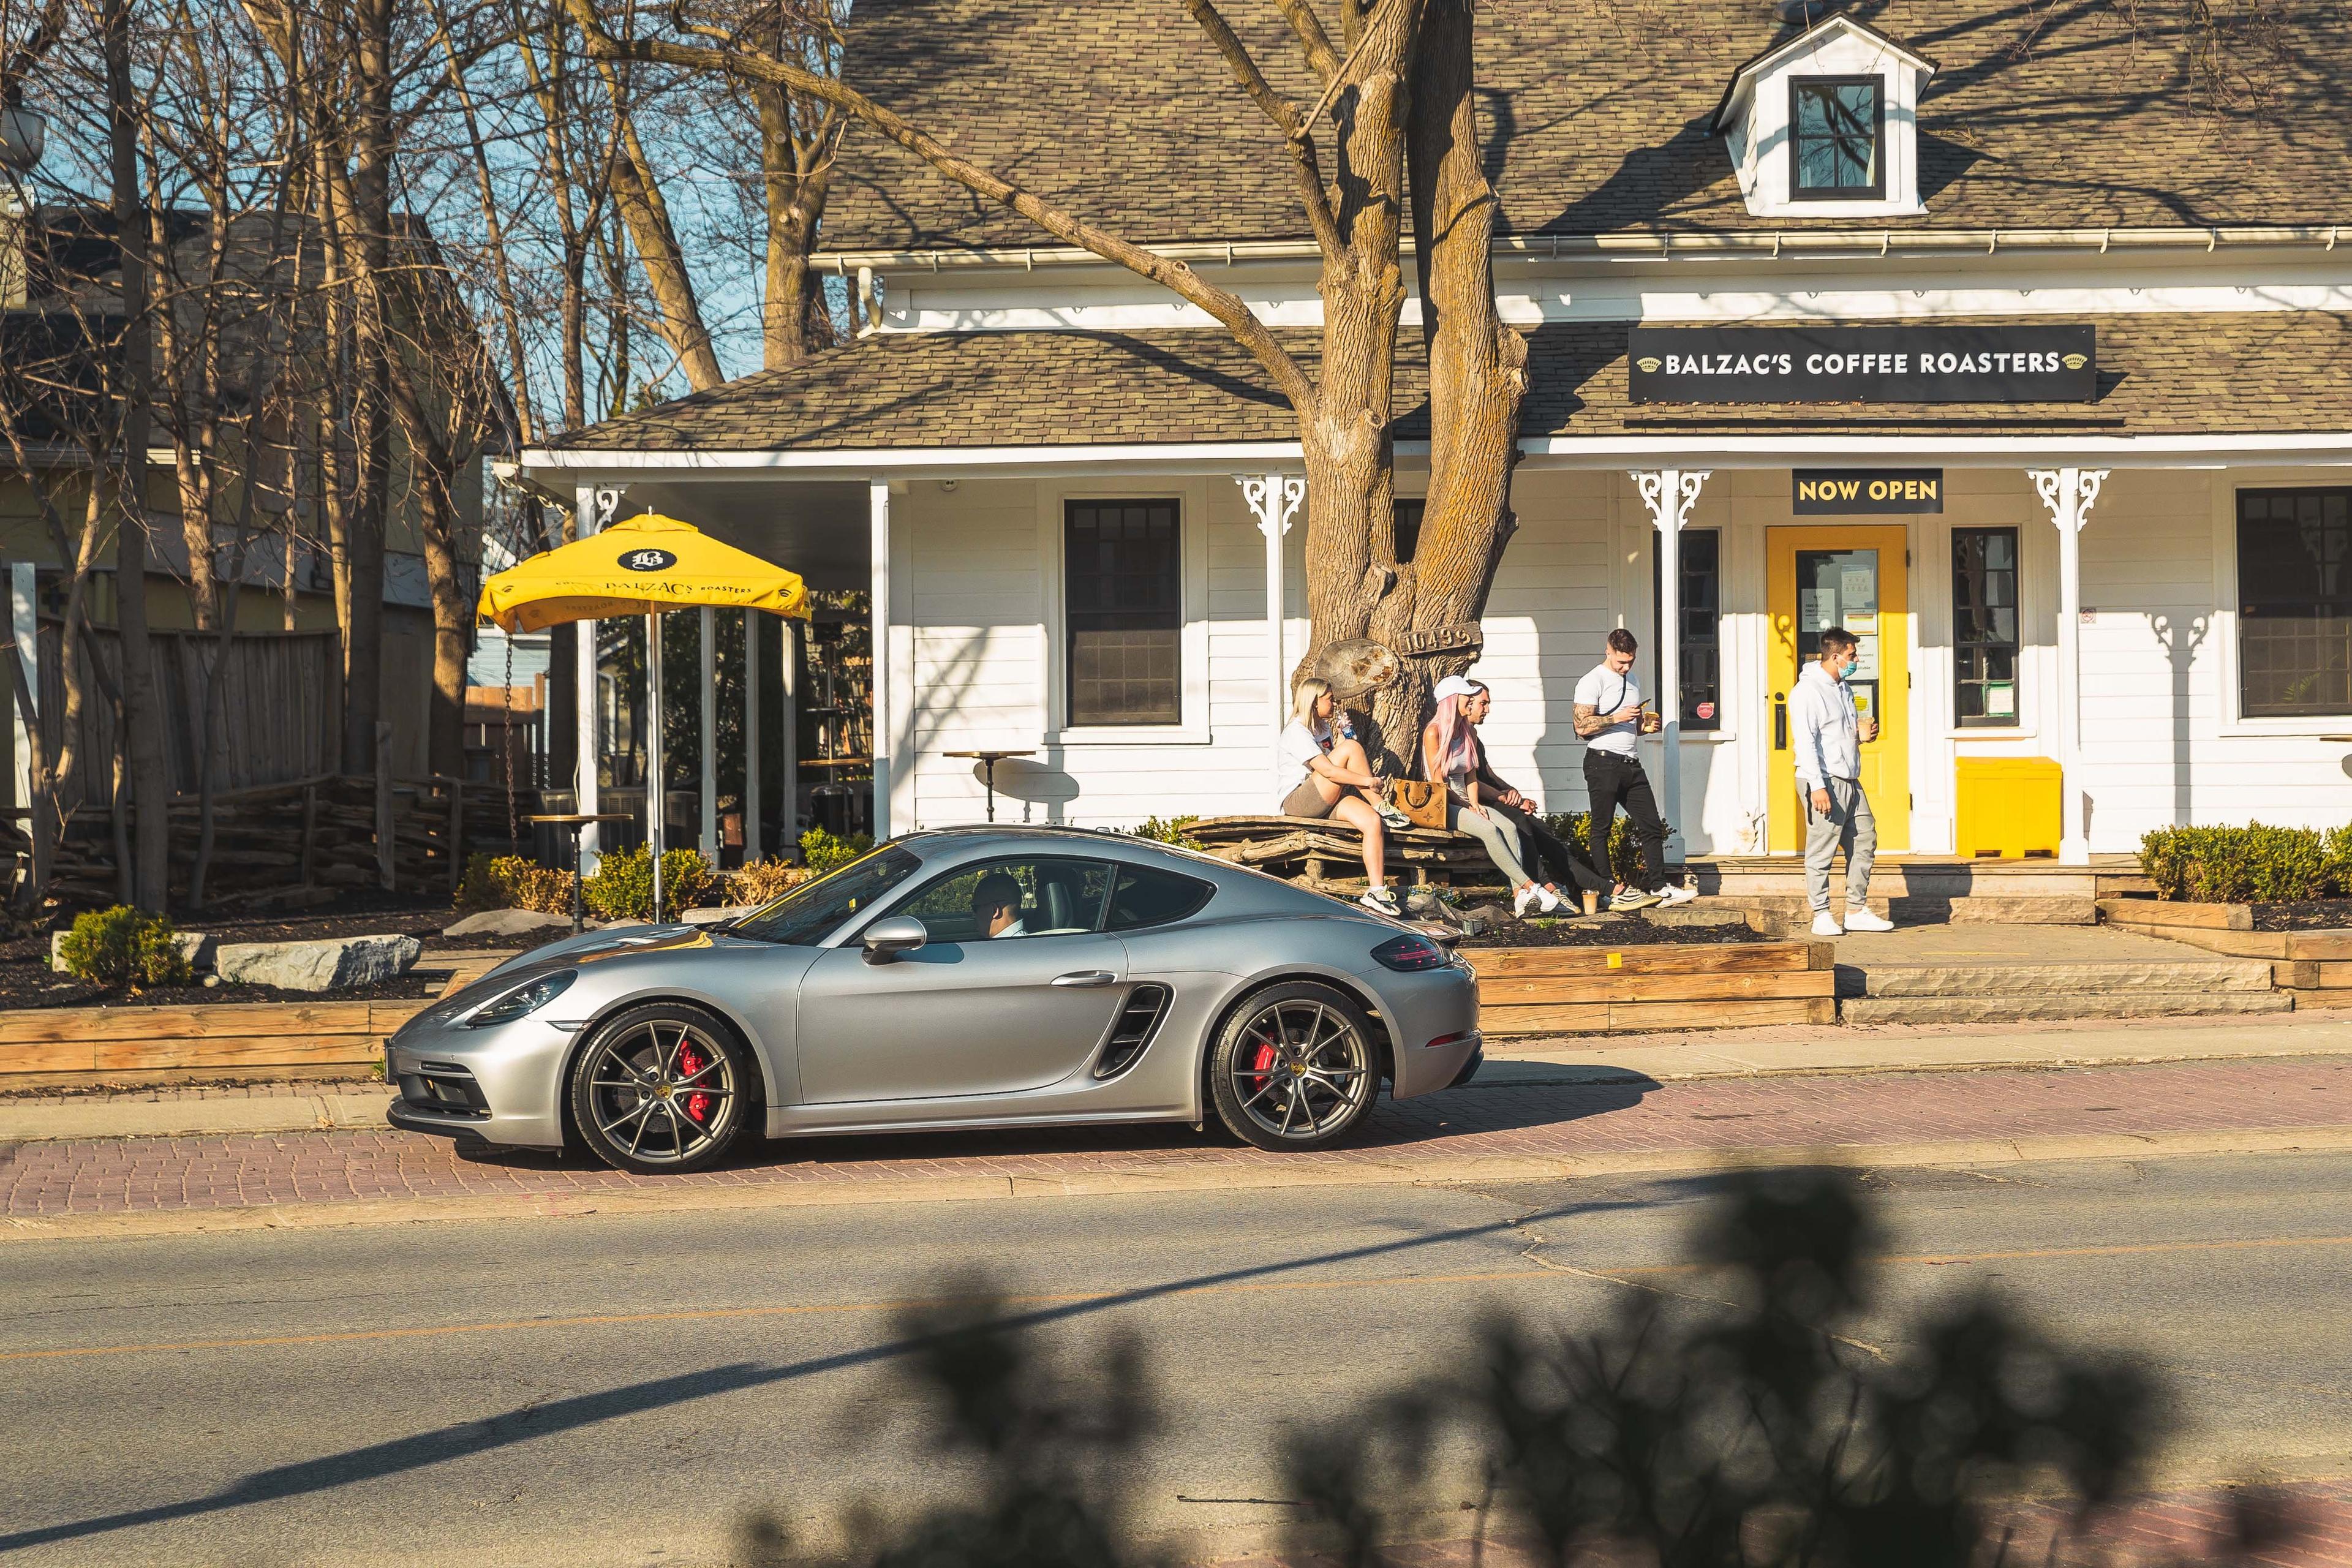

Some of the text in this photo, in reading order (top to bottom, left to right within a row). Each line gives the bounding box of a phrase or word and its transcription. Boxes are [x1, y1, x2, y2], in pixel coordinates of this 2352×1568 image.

[1665, 352, 2059, 375] BALZAC'S COFFEE ROASTERS
[1800, 480, 1937, 501] NOW OPEN
[1403, 628, 1471, 653] 10499
